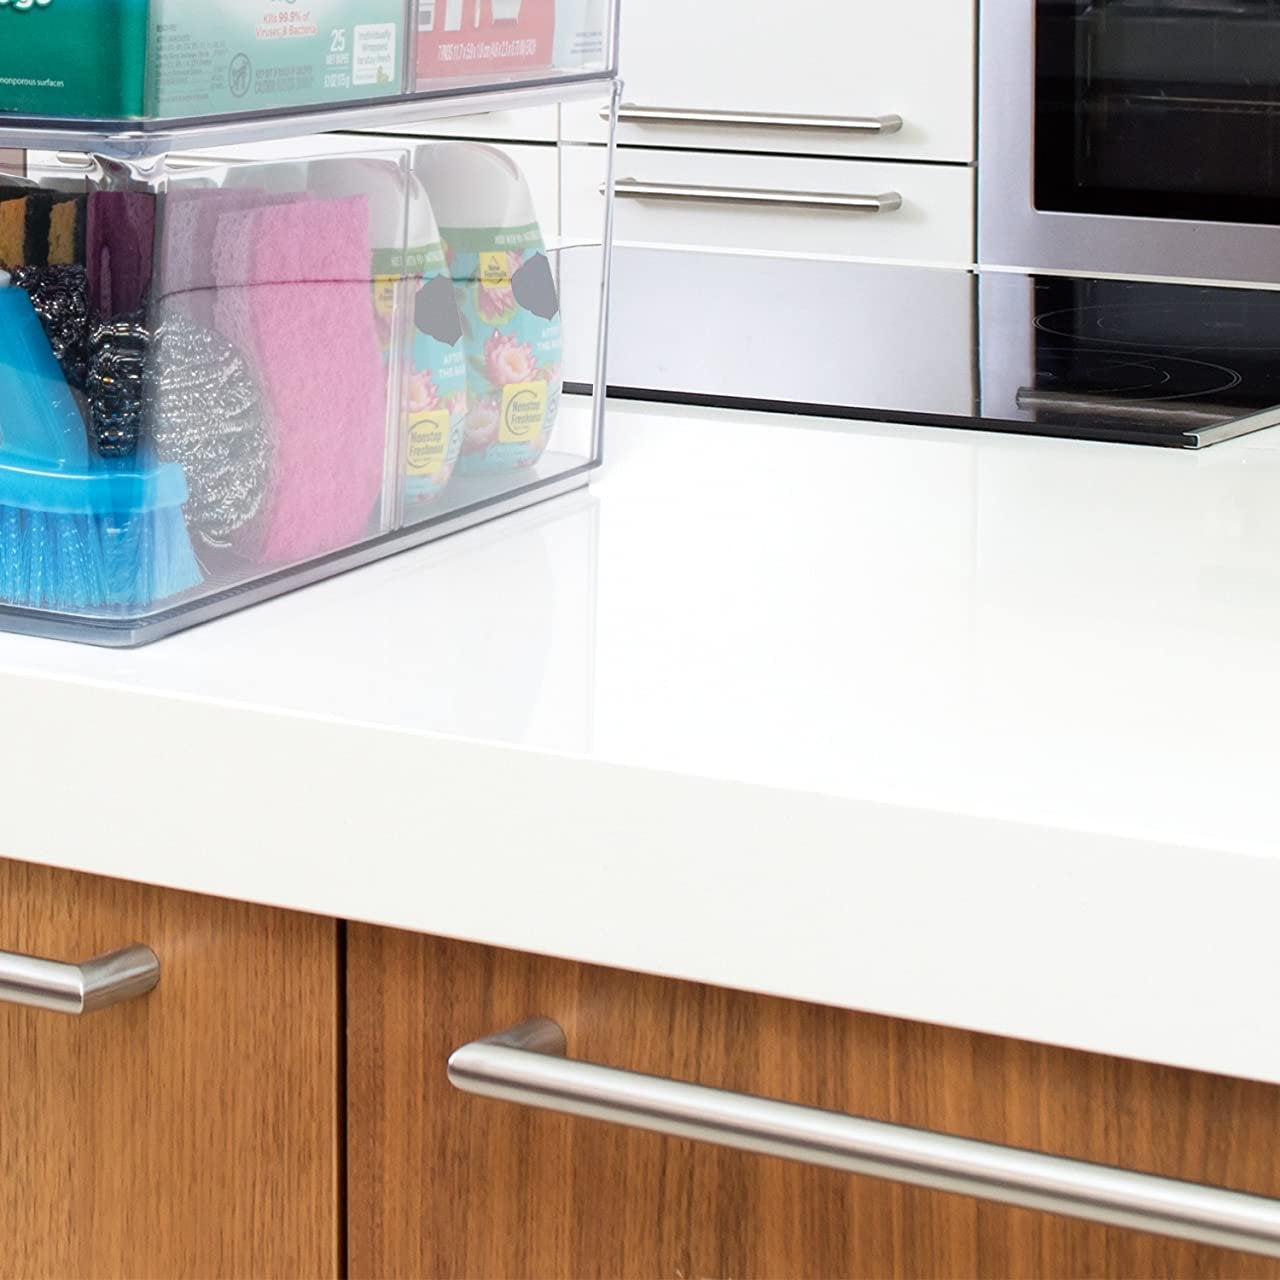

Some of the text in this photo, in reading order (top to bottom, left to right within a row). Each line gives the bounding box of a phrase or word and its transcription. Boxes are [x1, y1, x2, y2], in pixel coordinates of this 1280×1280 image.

[330, 28, 346, 52] 25
[0, 76, 37, 86] nonporous
[37, 77, 65, 88] surfaces
